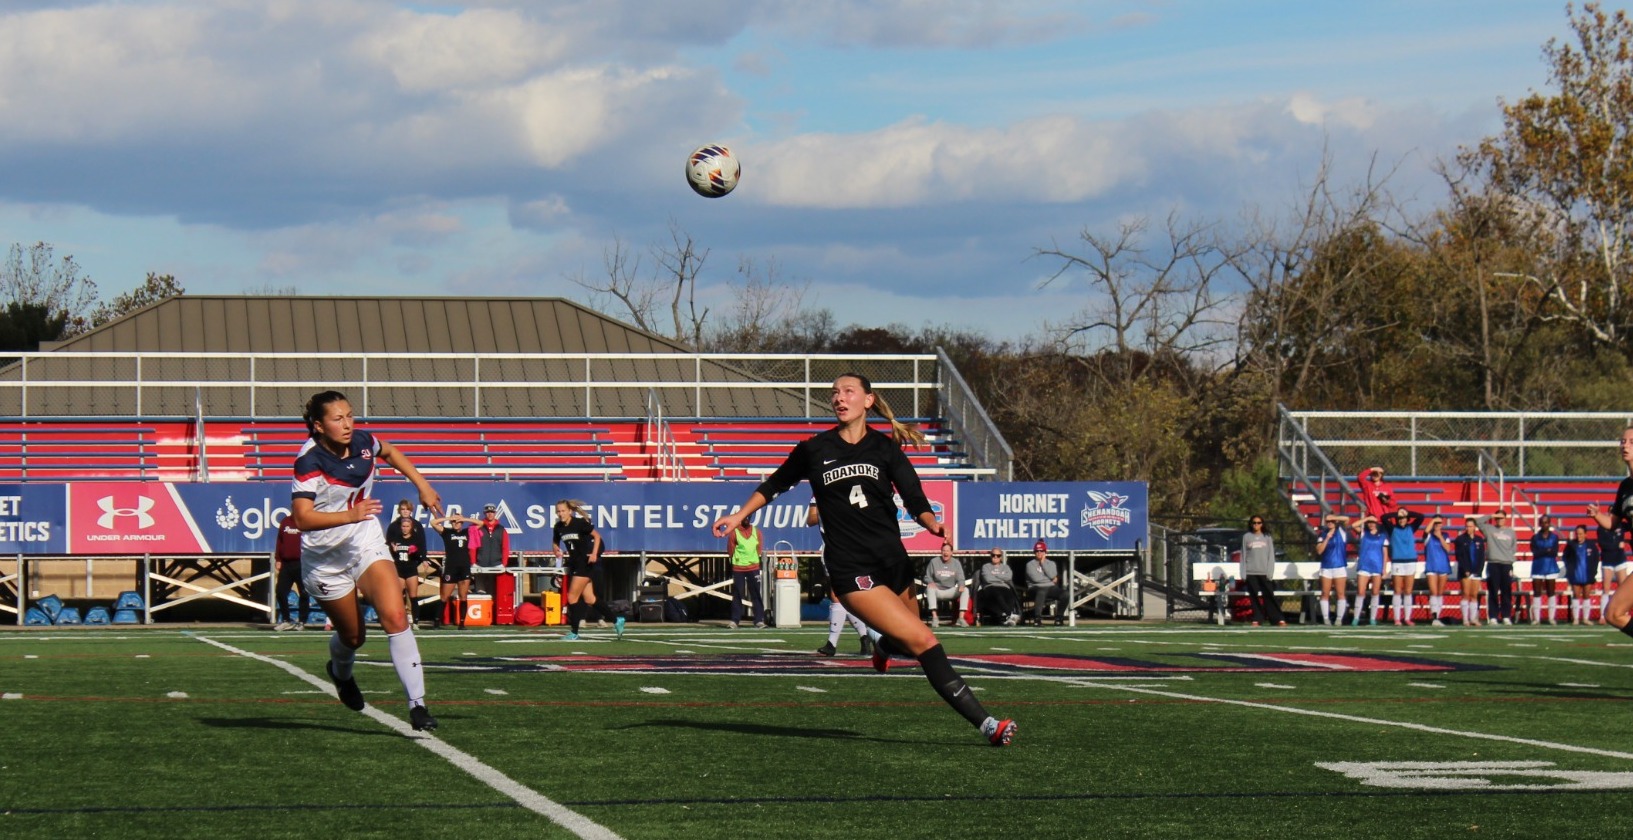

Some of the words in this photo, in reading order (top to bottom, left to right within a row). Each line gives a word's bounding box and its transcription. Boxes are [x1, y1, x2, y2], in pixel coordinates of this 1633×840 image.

[823, 464, 880, 485] ROANOKE
[849, 484, 868, 508] 4
[1000, 494, 1069, 513] HORNET
[1082, 508, 1130, 524] SHENANDOAH
[86, 534, 121, 542] UNDER
[122, 534, 166, 542] ARMOUR
[974, 519, 1069, 538] ATHLETICS
[467, 604, 482, 619] G
